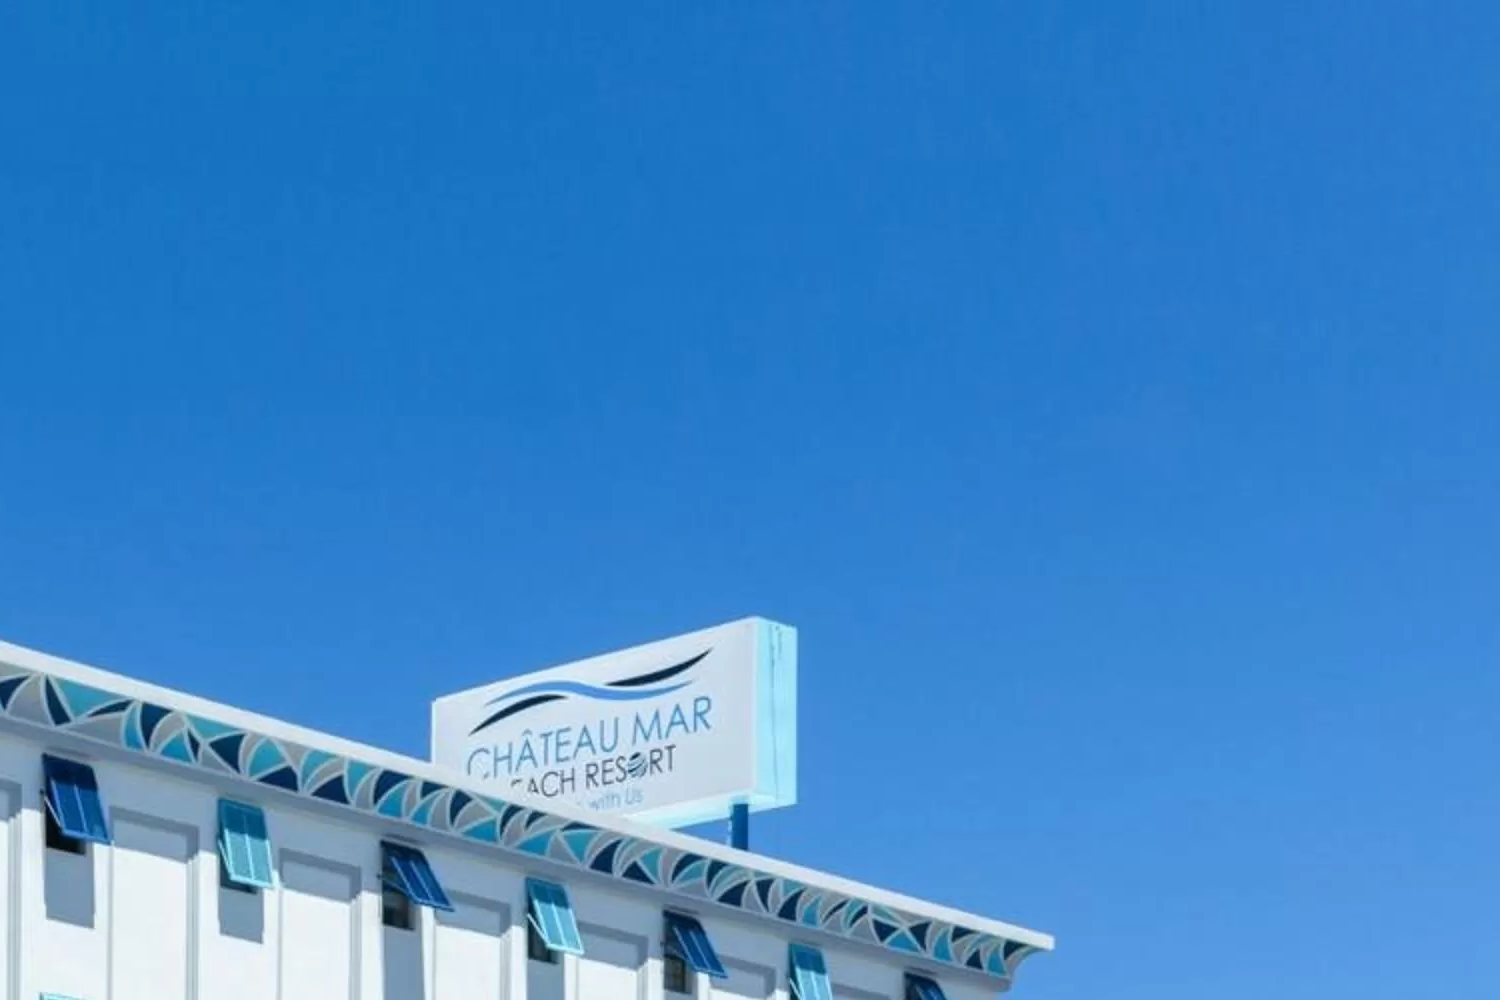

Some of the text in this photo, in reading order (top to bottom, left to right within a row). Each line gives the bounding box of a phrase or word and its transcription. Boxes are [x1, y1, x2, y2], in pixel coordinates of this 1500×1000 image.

[467, 696, 712, 780] CHÂTEAU MAR
[584, 744, 677, 790] RESORT
